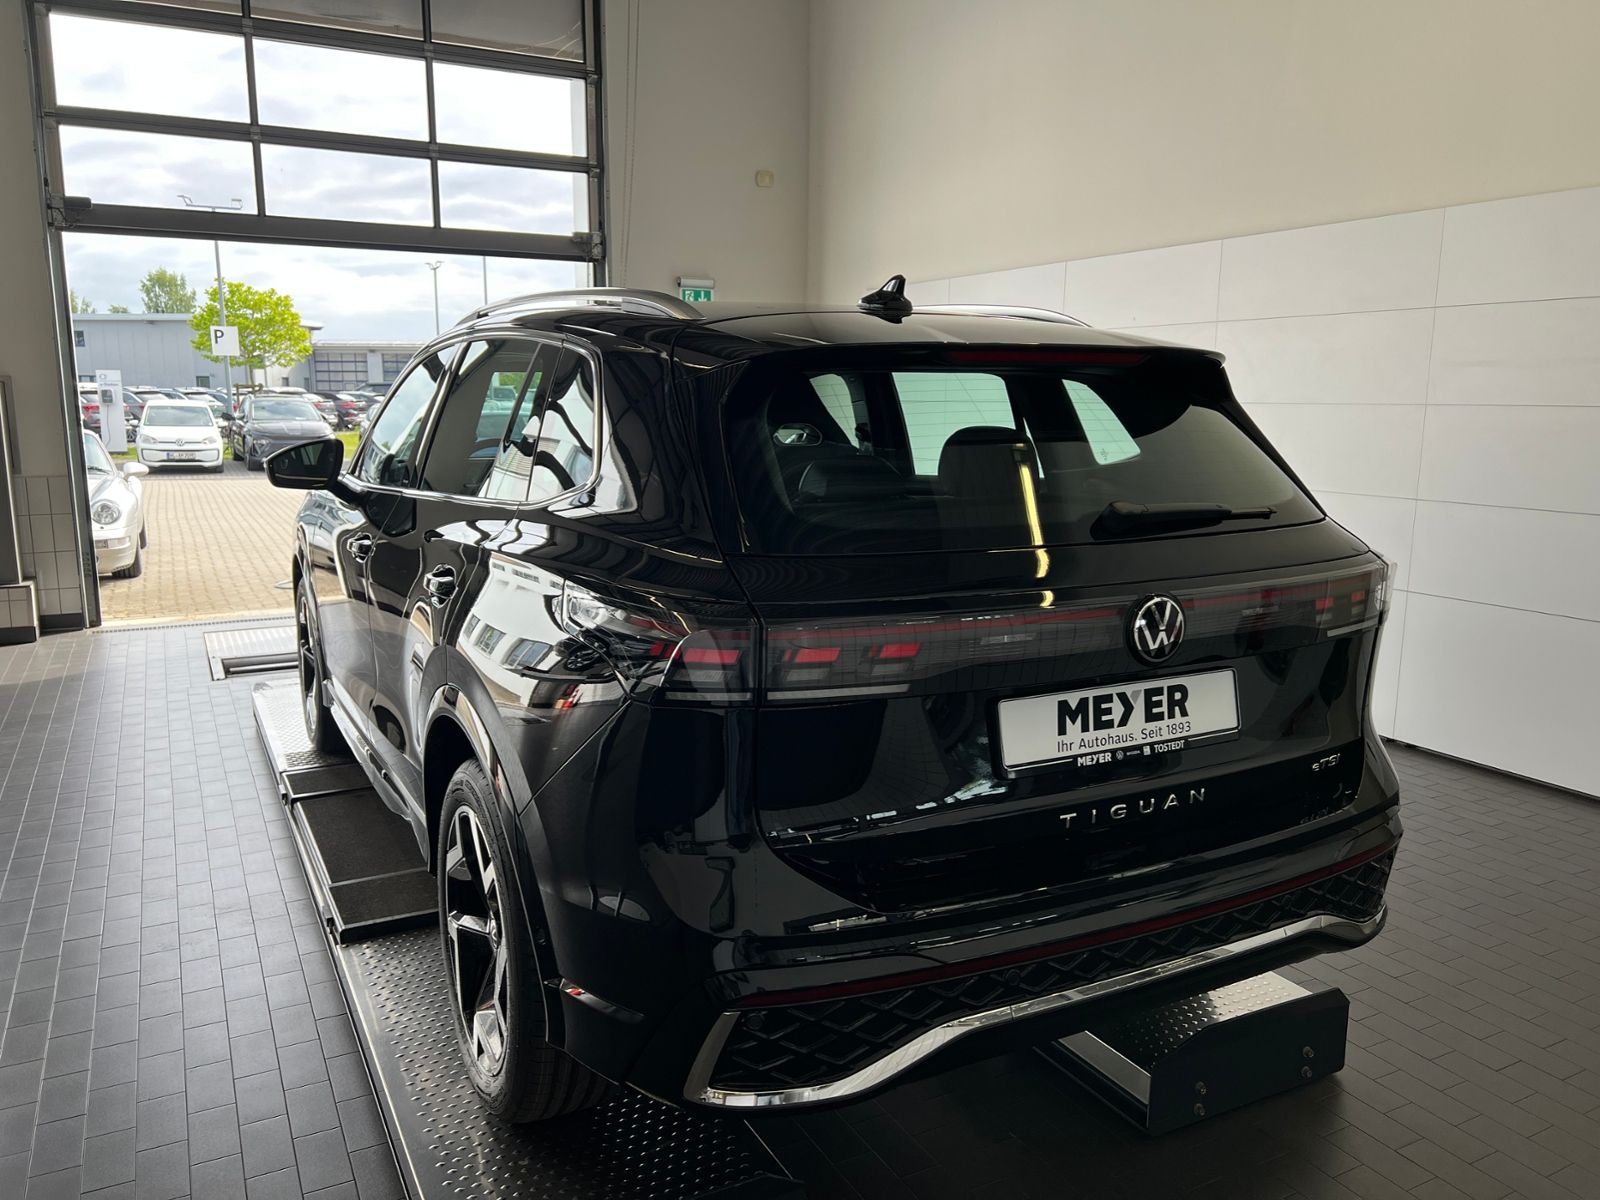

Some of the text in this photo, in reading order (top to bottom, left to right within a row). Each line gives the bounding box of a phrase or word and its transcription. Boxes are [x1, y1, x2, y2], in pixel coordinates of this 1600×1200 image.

[214, 329, 225, 344] P
[1057, 684, 1189, 736] MEYER
[1057, 721, 1191, 754] Ihr Autohaus. Seit 1893
[1077, 752, 1112, 767] MEYER
[1154, 740, 1185, 753] TOSTEDT
[1060, 788, 1205, 829] TIGUAN
